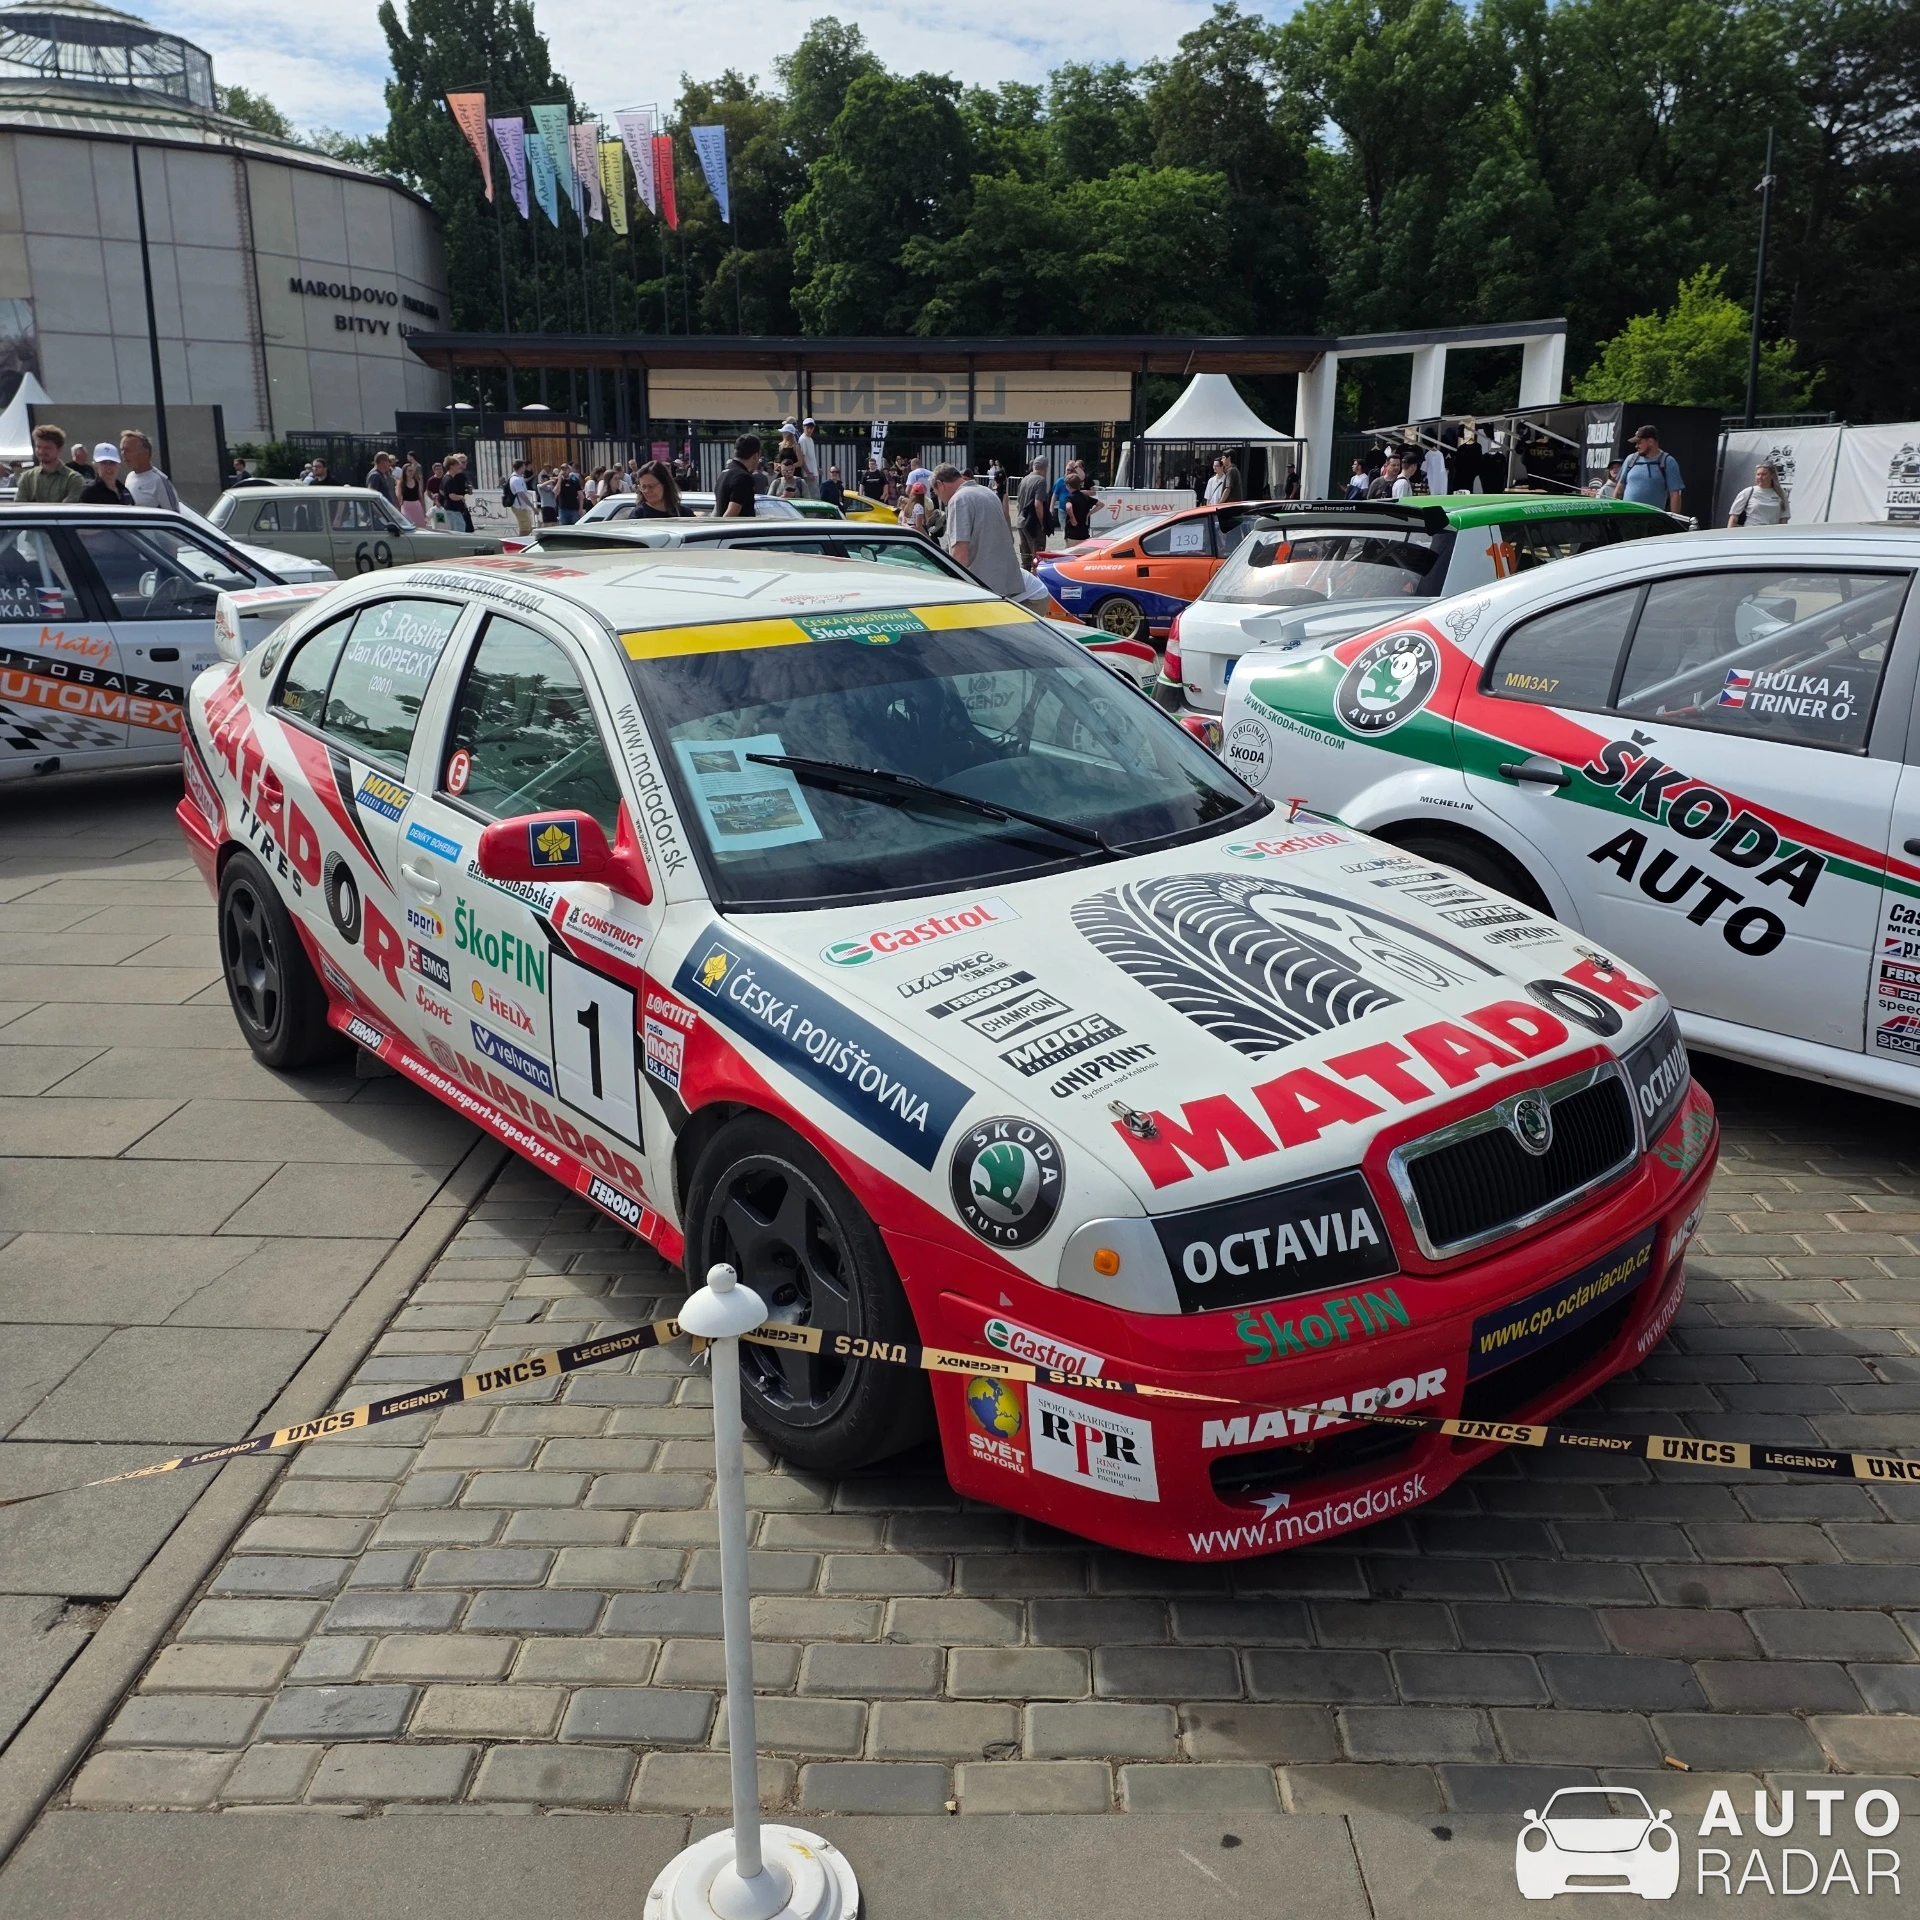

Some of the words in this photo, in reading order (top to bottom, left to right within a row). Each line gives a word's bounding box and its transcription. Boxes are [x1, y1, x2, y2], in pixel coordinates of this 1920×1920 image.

[289, 277, 399, 307] MAROLDOVO
[334, 314, 391, 337] BITVY
[1126, 503, 1176, 513] SEGWAY
[1312, 504, 1356, 512] motorsport
[355, 540, 393, 568] 69
[1176, 534, 1199, 547] 130
[802, 617, 842, 628] ČESKÁ
[867, 633, 891, 644] cup
[38, 626, 113, 668] Matěj
[348, 640, 371, 664] Jan
[370, 643, 440, 679] KOPECKÝ
[1505, 672, 1560, 694] MM3A7
[1754, 669, 1829, 697] HŮLKA
[1243, 692, 1346, 751] WWW.SKODA-AUTO.COM
[1348, 708, 1397, 726] AUTO
[1750, 692, 1828, 719] TRINER
[1232, 723, 1268, 747] ORIGINAL
[1229, 744, 1265, 764] ŠKODA
[362, 774, 413, 810] MOOG
[616, 704, 688, 877] www.matador.sk
[1419, 795, 1474, 811] MICHELIN
[1581, 728, 1829, 909] ŠKODA
[240, 797, 303, 898] TYRES
[408, 826, 433, 844] DENÍKY
[429, 837, 459, 857] BOHEMIA
[1255, 831, 1351, 856] Castrol
[1587, 827, 1787, 957] AUTO
[407, 906, 436, 935] sport
[580, 910, 644, 950] CONSTRUCT
[869, 904, 1000, 954] Castrol
[1442, 904, 1516, 923] MOOG
[453, 895, 546, 996] ŠkoFIN
[421, 955, 451, 984] EMOS
[645, 992, 697, 1030] LOCTITE
[949, 979, 1014, 1010] FERODO
[347, 1018, 382, 1048] FERODO
[489, 994, 536, 1036] HELIX
[646, 1021, 664, 1036] radio
[981, 996, 1057, 1034] CHAMPION
[577, 1000, 604, 1101] 1
[646, 1033, 681, 1067] most
[729, 968, 799, 1036] ČESKÁ
[791, 1017, 931, 1133] POJIŠŤOVNA
[1009, 1015, 1112, 1068] MOOG
[1027, 1041, 1079, 1074] CHASSIS
[496, 1040, 551, 1089] velvana
[648, 1060, 667, 1080] 95.8
[665, 1069, 678, 1087] fm
[1050, 1042, 1158, 1100] UNIPRINT
[1081, 1080, 1114, 1102] Rychnov
[1113, 1074, 1128, 1088] nad
[1126, 1061, 1160, 1081] Kněžnou
[1111, 961, 1661, 1191] MATADOR
[1640, 1038, 1691, 1118] OCTAVIA
[400, 1053, 563, 1168] www.motorsport-kopecky.cz
[453, 1050, 654, 1205] MATADOR
[972, 1122, 1058, 1186] ŠKODA
[590, 1179, 642, 1224] FERODO
[964, 1205, 1019, 1241] AUTO
[1182, 1207, 1380, 1283] OCTAVIA
[1480, 1243, 1652, 1354] www.cp.octaviacup.cz
[1233, 1287, 1411, 1365] ŠkoFIN
[834, 1334, 908, 1364] UNCS
[935, 1353, 1010, 1375] LEGENDY
[1010, 1331, 1087, 1376] Castrol
[191, 1438, 262, 1464] LEGENDY
[286, 1410, 357, 1443] UNCS
[380, 1388, 451, 1417] LEGENDY
[475, 1358, 548, 1393] UNCS
[571, 1333, 643, 1362] LEGENDY
[1049, 1370, 1123, 1392] UNCS
[1038, 1398, 1068, 1416] SPORT
[1077, 1411, 1135, 1436] MARKETING
[1201, 1367, 1448, 1449] MATADOR
[969, 1432, 1026, 1465] SVĚT
[1038, 1409, 1142, 1478] RPR
[1354, 1412, 1429, 1428] LEGENDY
[1456, 1420, 1532, 1443] UNCS
[1559, 1433, 1633, 1451] LEGENDY
[1661, 1439, 1736, 1464] UNCS
[1765, 1452, 1837, 1470] LEGENDY
[972, 1448, 1025, 1475] MOTORŮ
[1096, 1456, 1121, 1471] RING
[1096, 1466, 1142, 1483] promotion
[1097, 1474, 1126, 1488] racing
[1188, 1472, 1428, 1555] www.matador.sk
